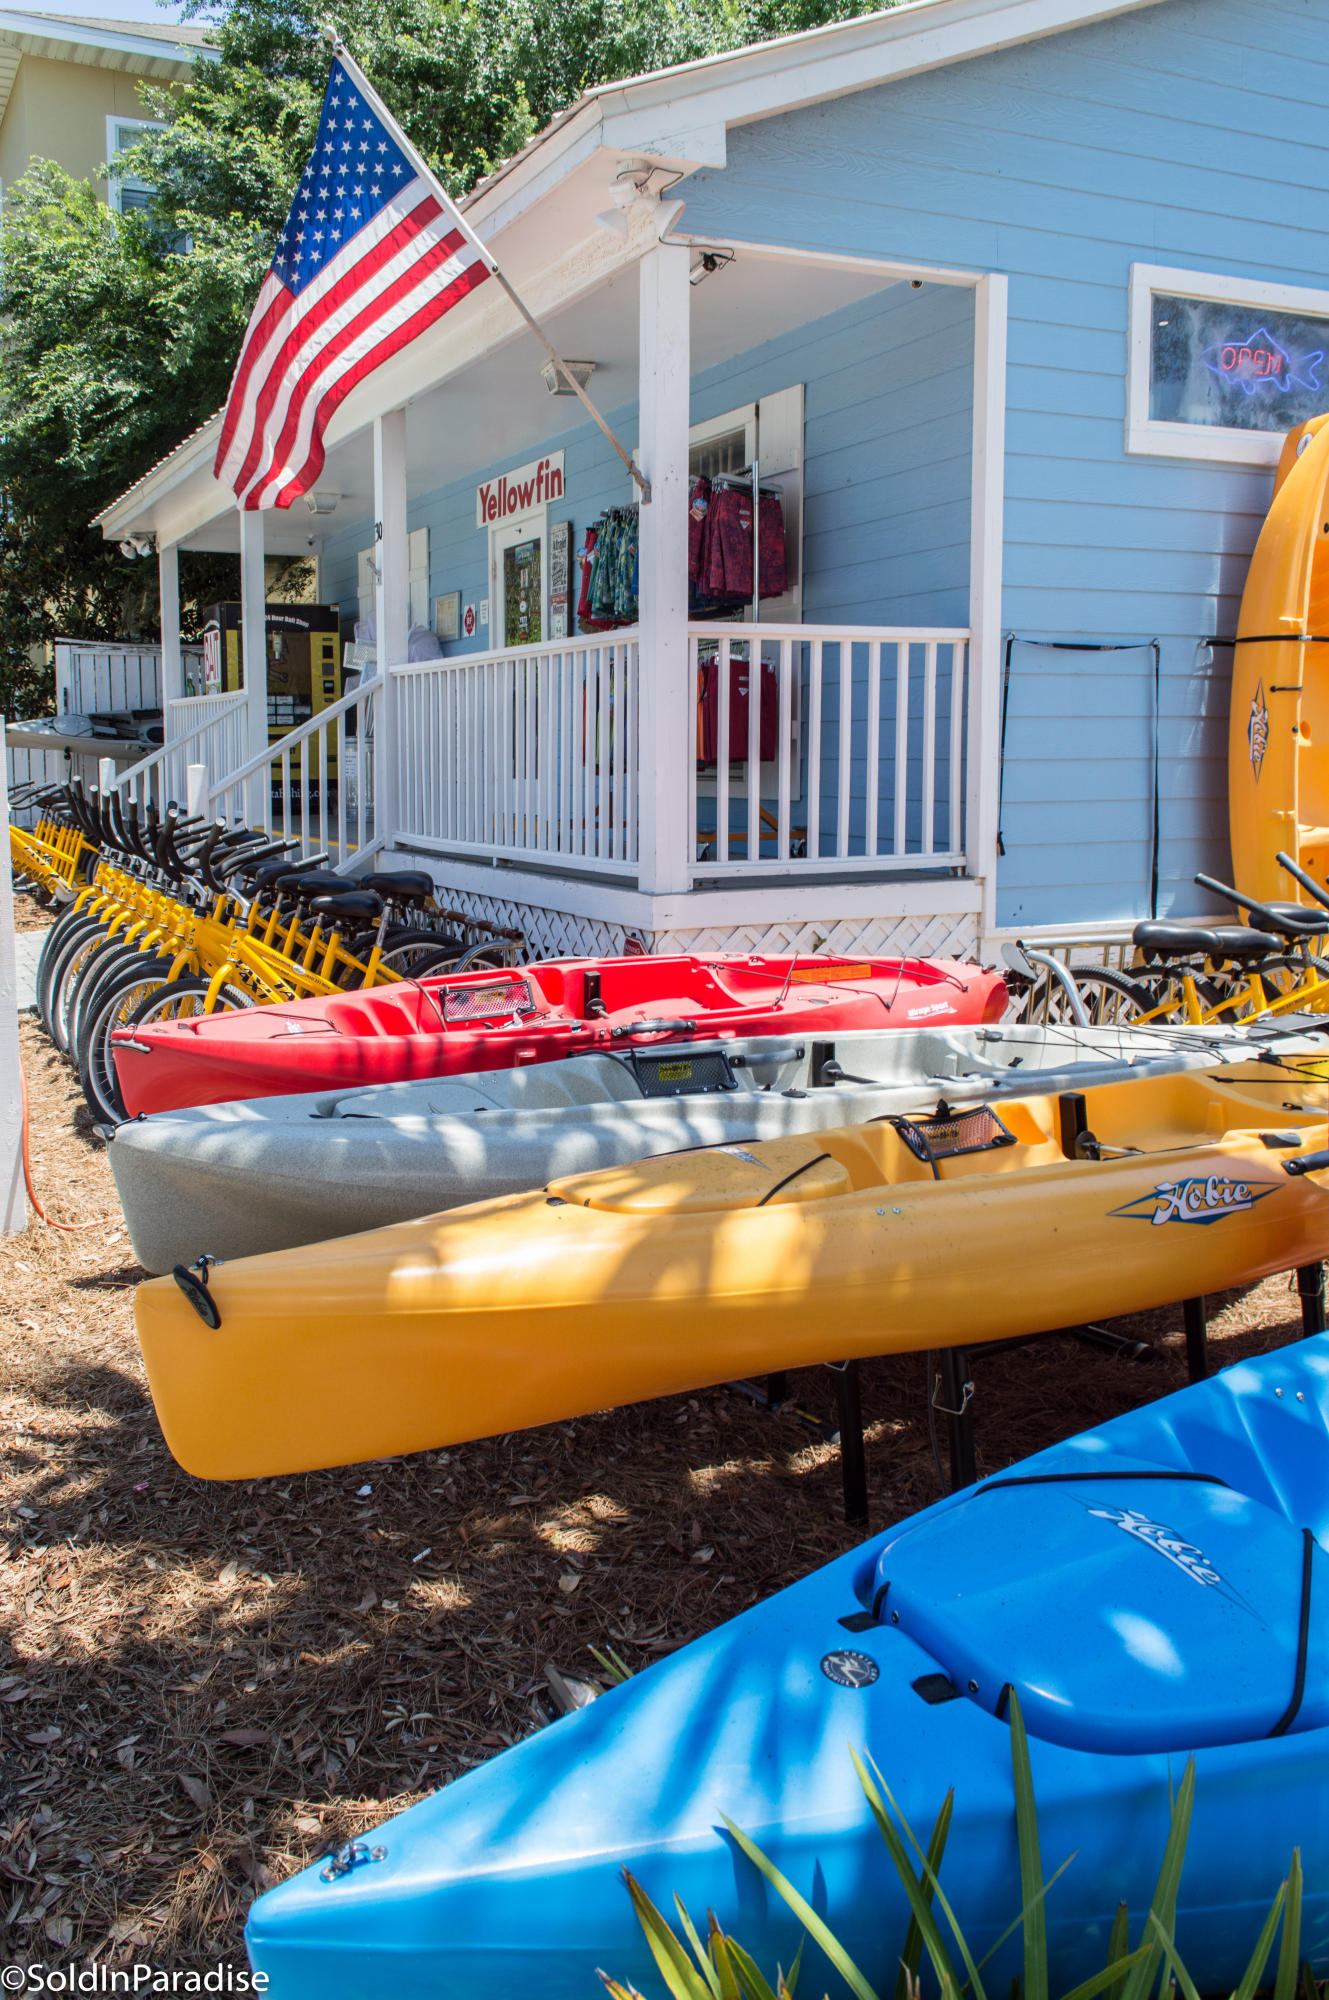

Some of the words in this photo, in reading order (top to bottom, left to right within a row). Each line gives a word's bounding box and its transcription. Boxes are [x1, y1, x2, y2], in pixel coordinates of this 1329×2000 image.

[1222, 347, 1282, 375] OPEN
[479, 458, 562, 524] Yellowfin
[1249, 700, 1268, 762] Hobie
[1152, 1175, 1253, 1225] Hobie
[1088, 1510, 1220, 1585] Hobie
